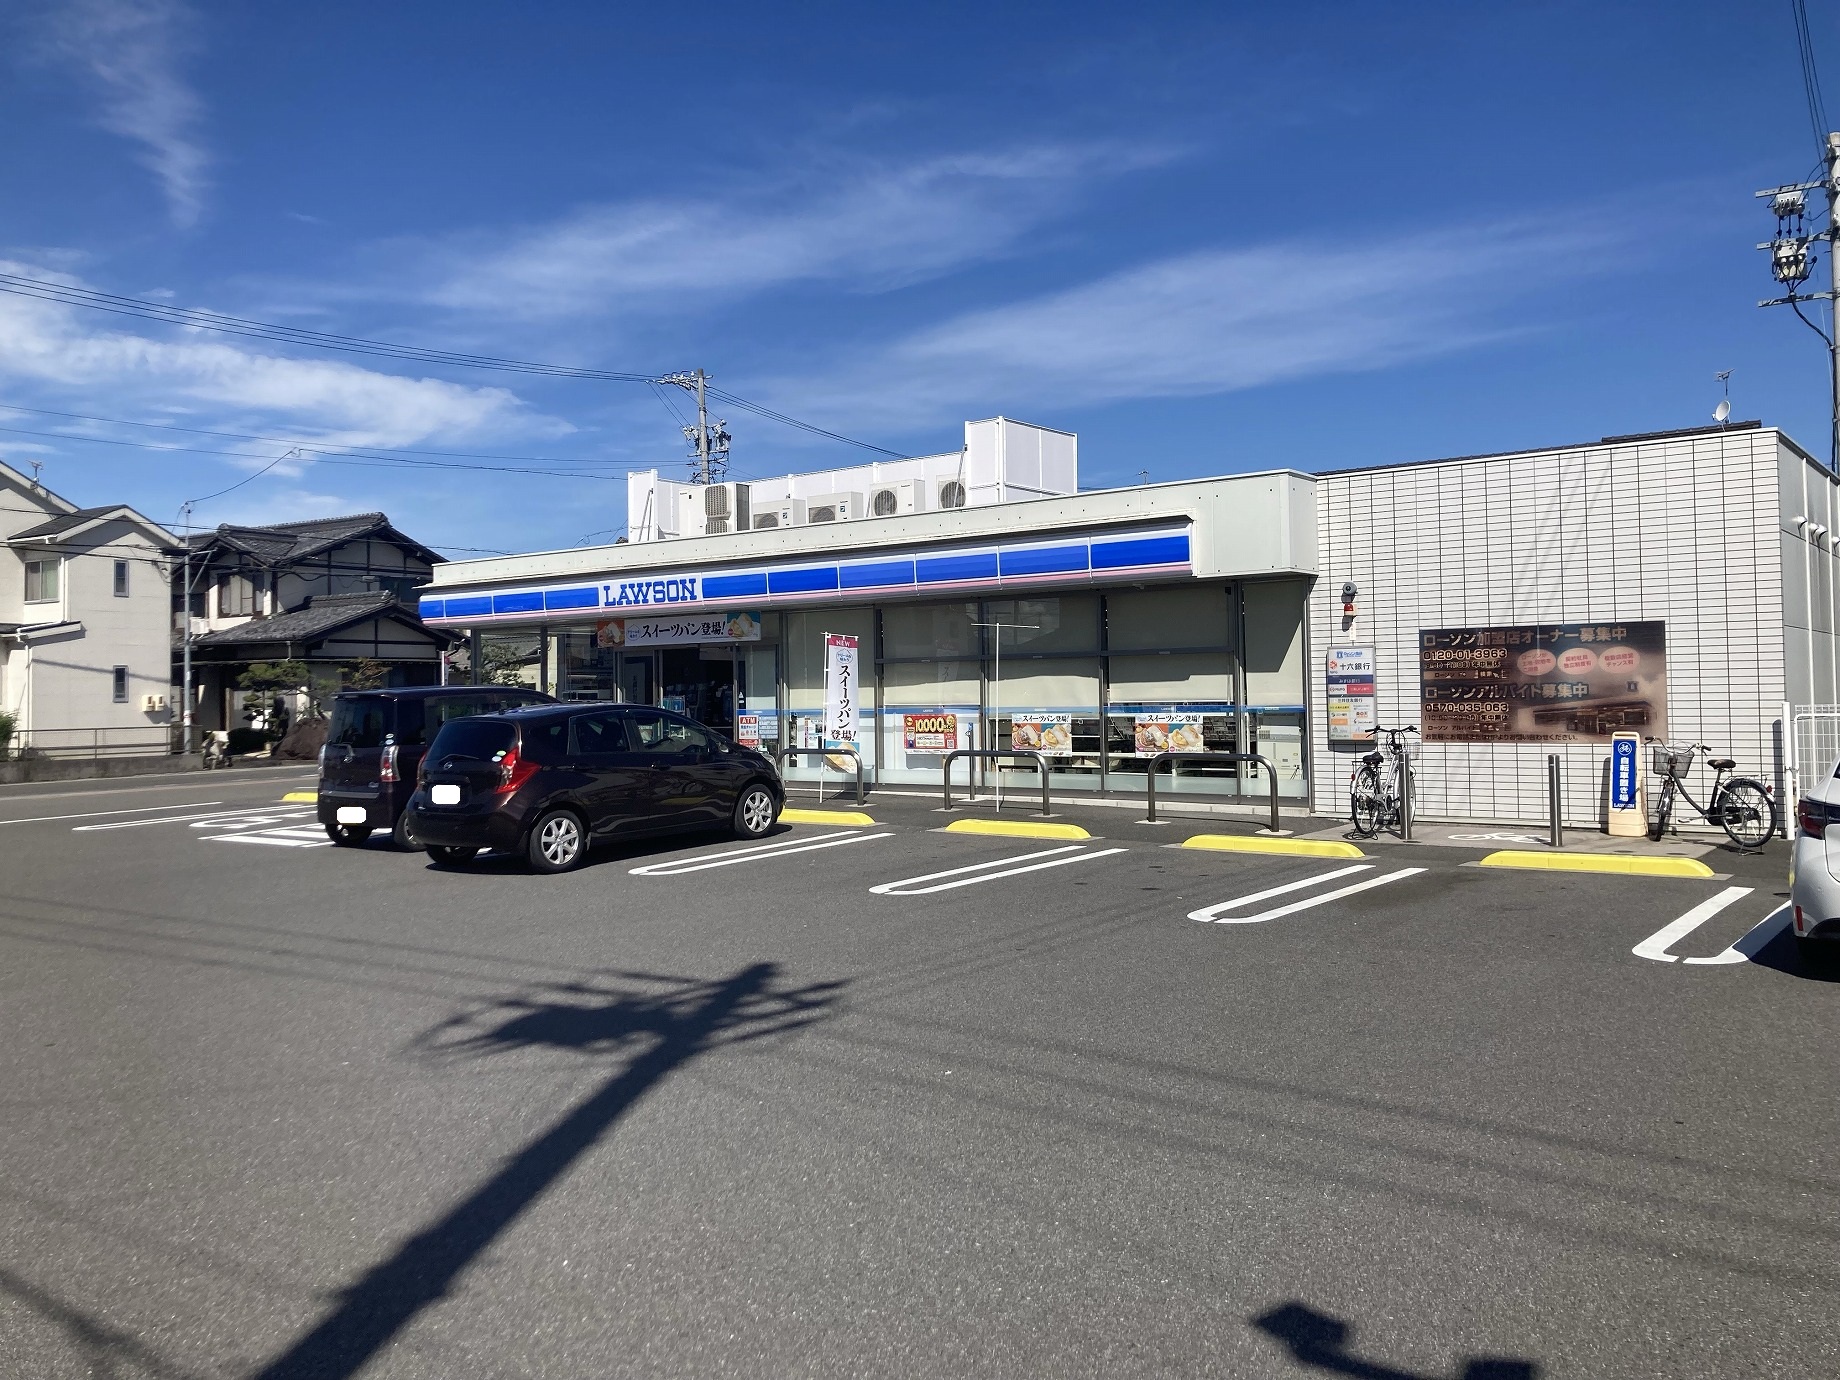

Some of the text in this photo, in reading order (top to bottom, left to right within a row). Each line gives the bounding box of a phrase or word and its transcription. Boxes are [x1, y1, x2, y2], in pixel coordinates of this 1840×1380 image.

[603, 578, 697, 606] LAWSON
[1423, 627, 1627, 647] ローソン加盟店オーナー募集中
[1423, 648, 1508, 661] 0120-01-3963
[1340, 662, 1371, 671] 十六銀行
[1425, 683, 1589, 699] ローソンアルバイト募集中
[1425, 702, 1509, 713] 0570-035-063
[1619, 756, 1629, 802] 自転車置き場
